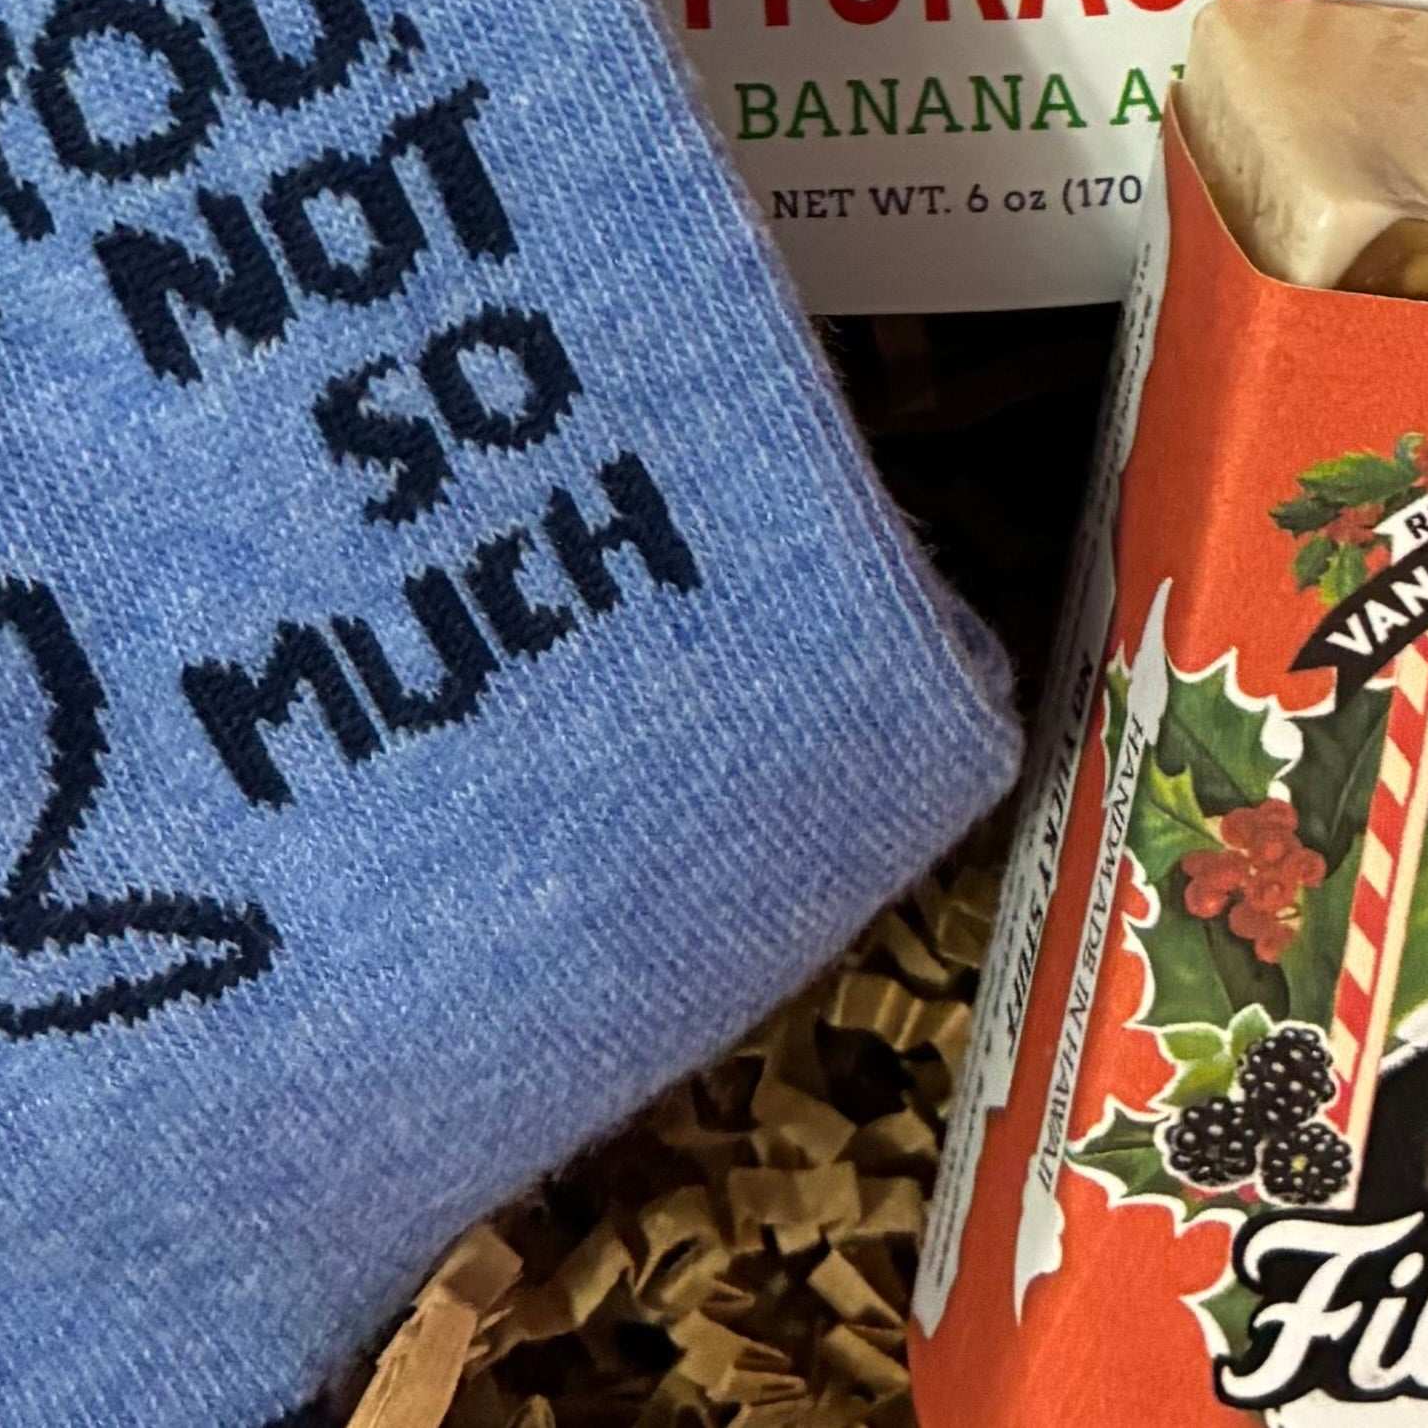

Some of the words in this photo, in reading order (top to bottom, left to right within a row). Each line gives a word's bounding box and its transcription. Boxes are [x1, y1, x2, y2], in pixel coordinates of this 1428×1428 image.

[734, 73, 1088, 140] BANANA
[95, 80, 519, 386] NOT
[773, 187, 855, 219] NET
[868, 184, 952, 215] WT.
[966, 183, 990, 214] 6
[1003, 187, 1047, 212] oz
[1062, 174, 1143, 216] (170
[314, 302, 582, 527] SO
[183, 451, 703, 809] MUCH
[1083, 710, 1145, 977] HANDMADE
[1006, 888, 1045, 1059] STUFF
[1071, 980, 1091, 1016] IN
[1037, 1023, 1079, 1194] HAWAII
